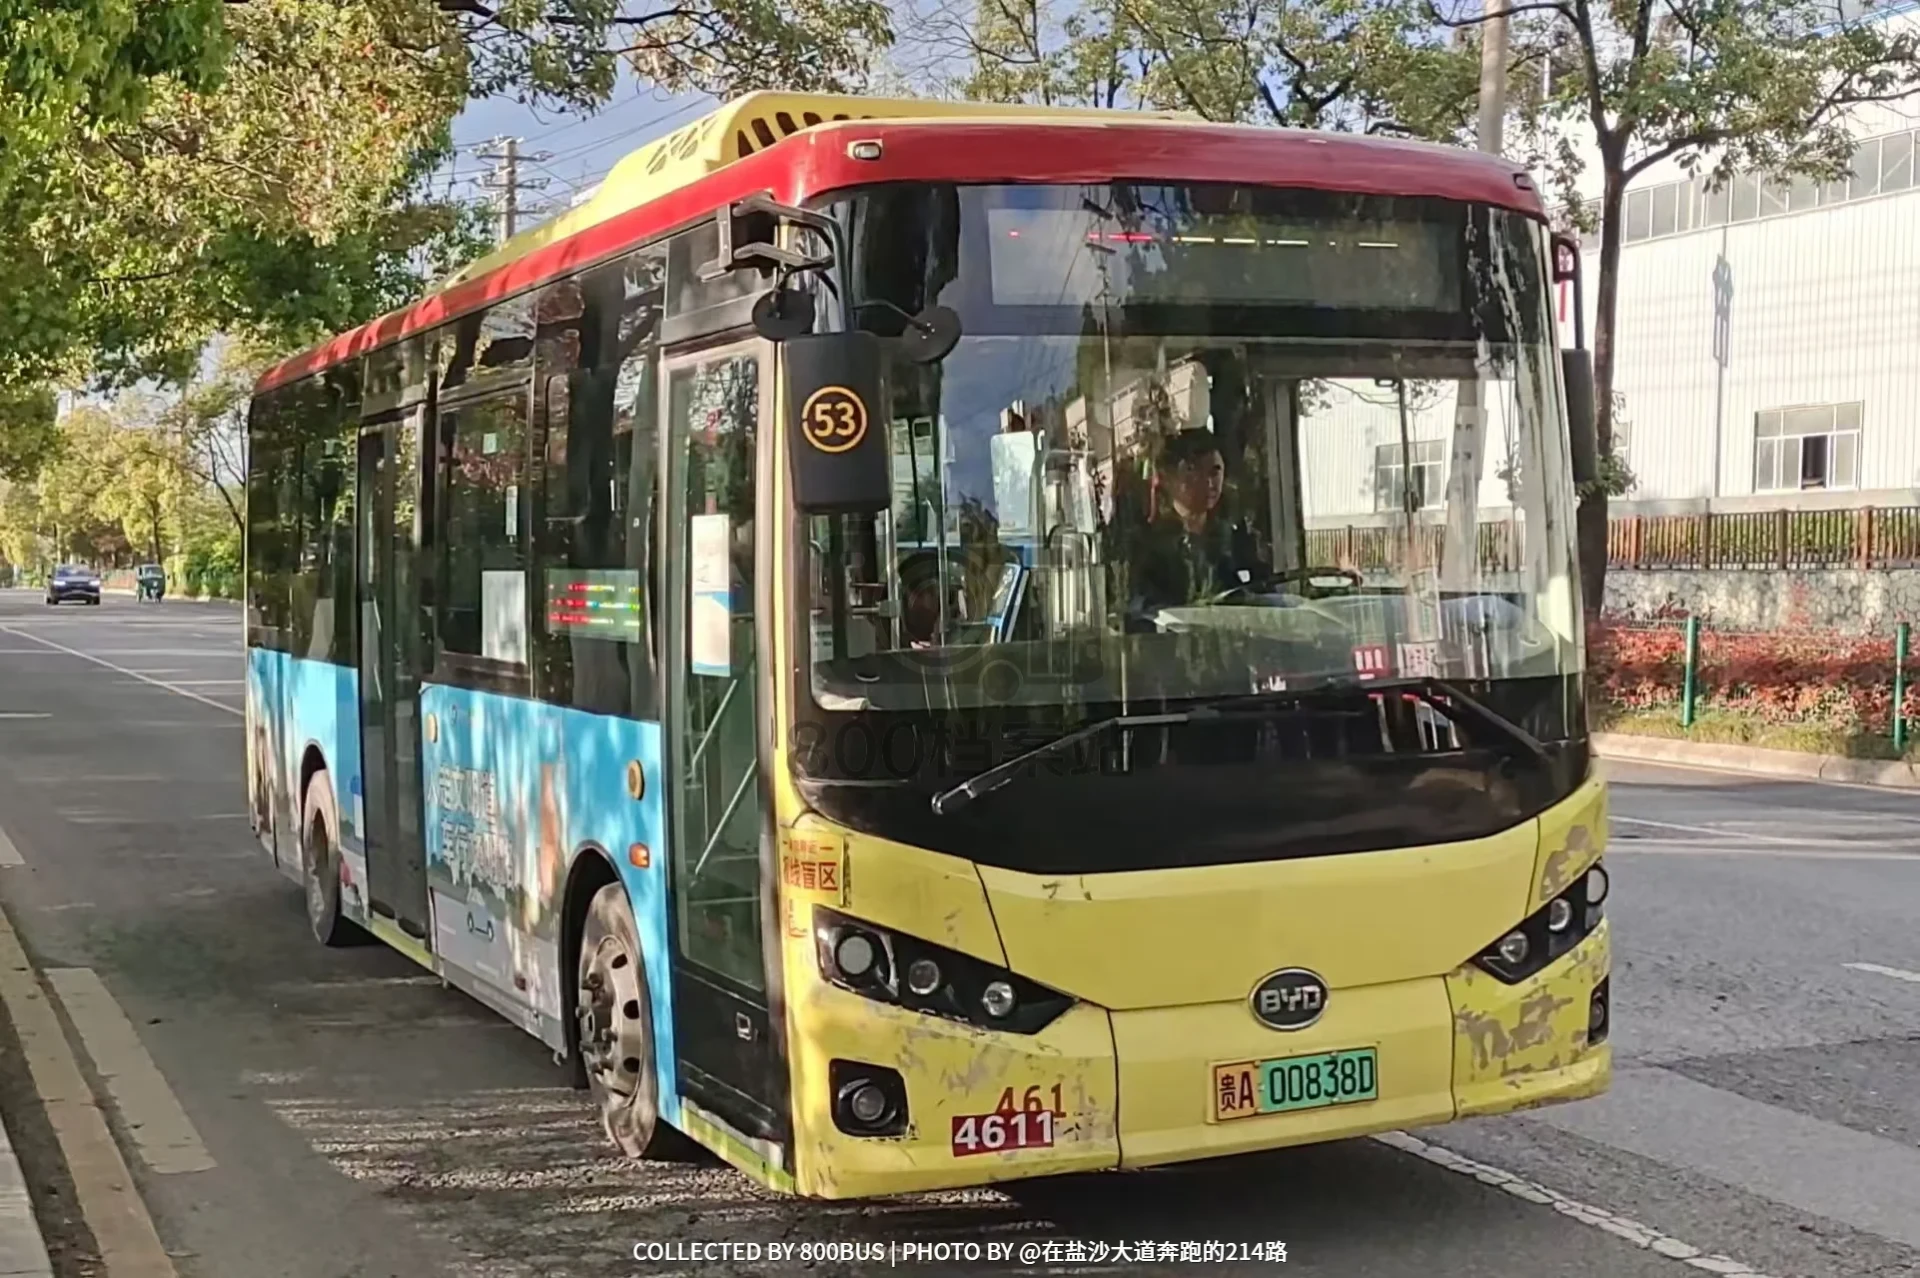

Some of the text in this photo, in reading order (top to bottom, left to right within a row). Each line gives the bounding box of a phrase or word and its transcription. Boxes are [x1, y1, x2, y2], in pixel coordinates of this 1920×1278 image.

[814, 401, 856, 437] 53
[1260, 985, 1322, 1014] BYD
[954, 1111, 1052, 1150] 4611
